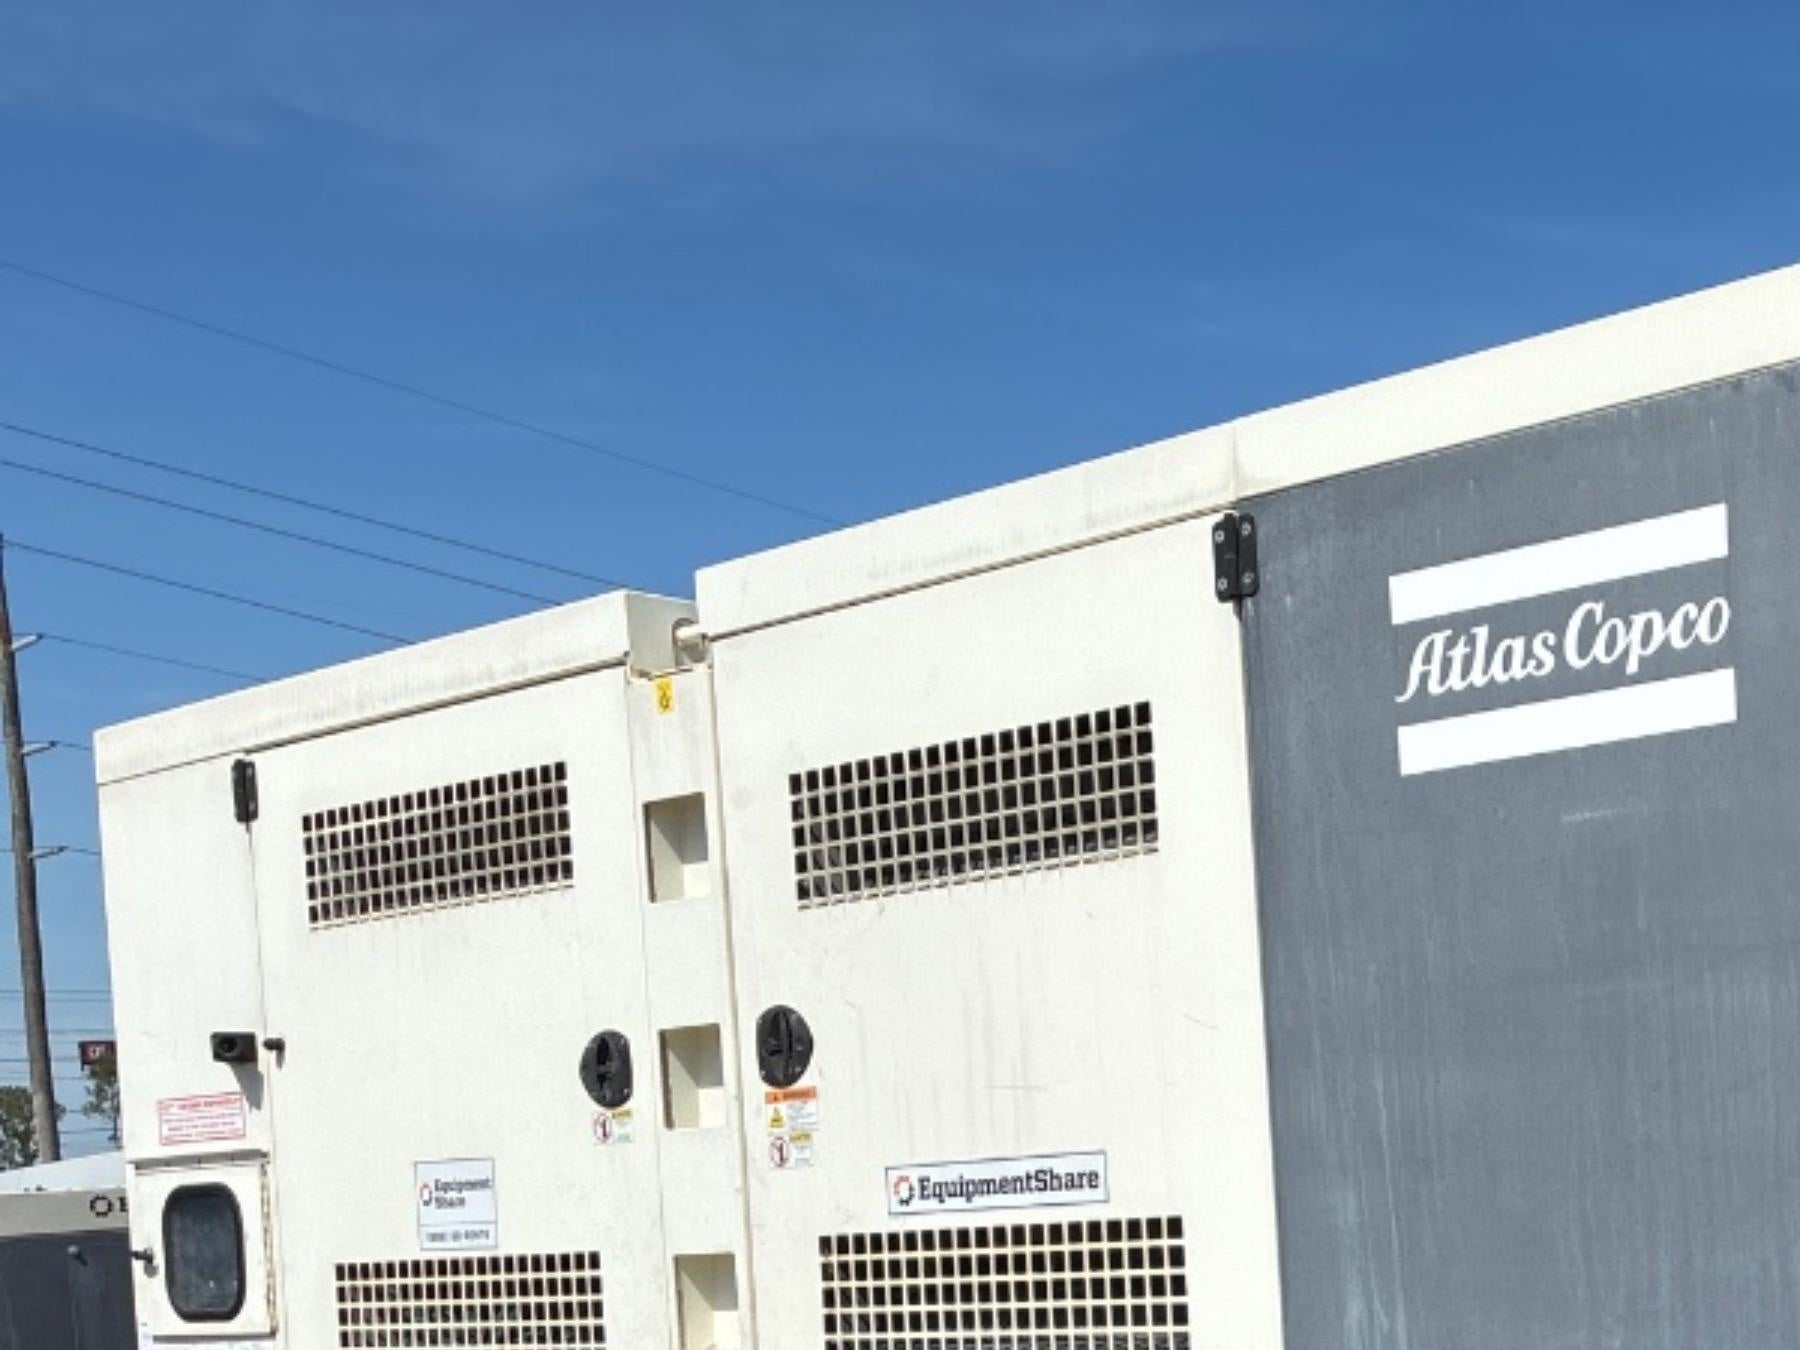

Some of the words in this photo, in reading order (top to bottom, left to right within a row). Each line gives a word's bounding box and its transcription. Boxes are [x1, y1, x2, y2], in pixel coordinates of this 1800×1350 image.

[1395, 623, 1557, 703] Atlas
[1563, 596, 1731, 676] Copco
[917, 1166, 1100, 1204] EquipmentShare
